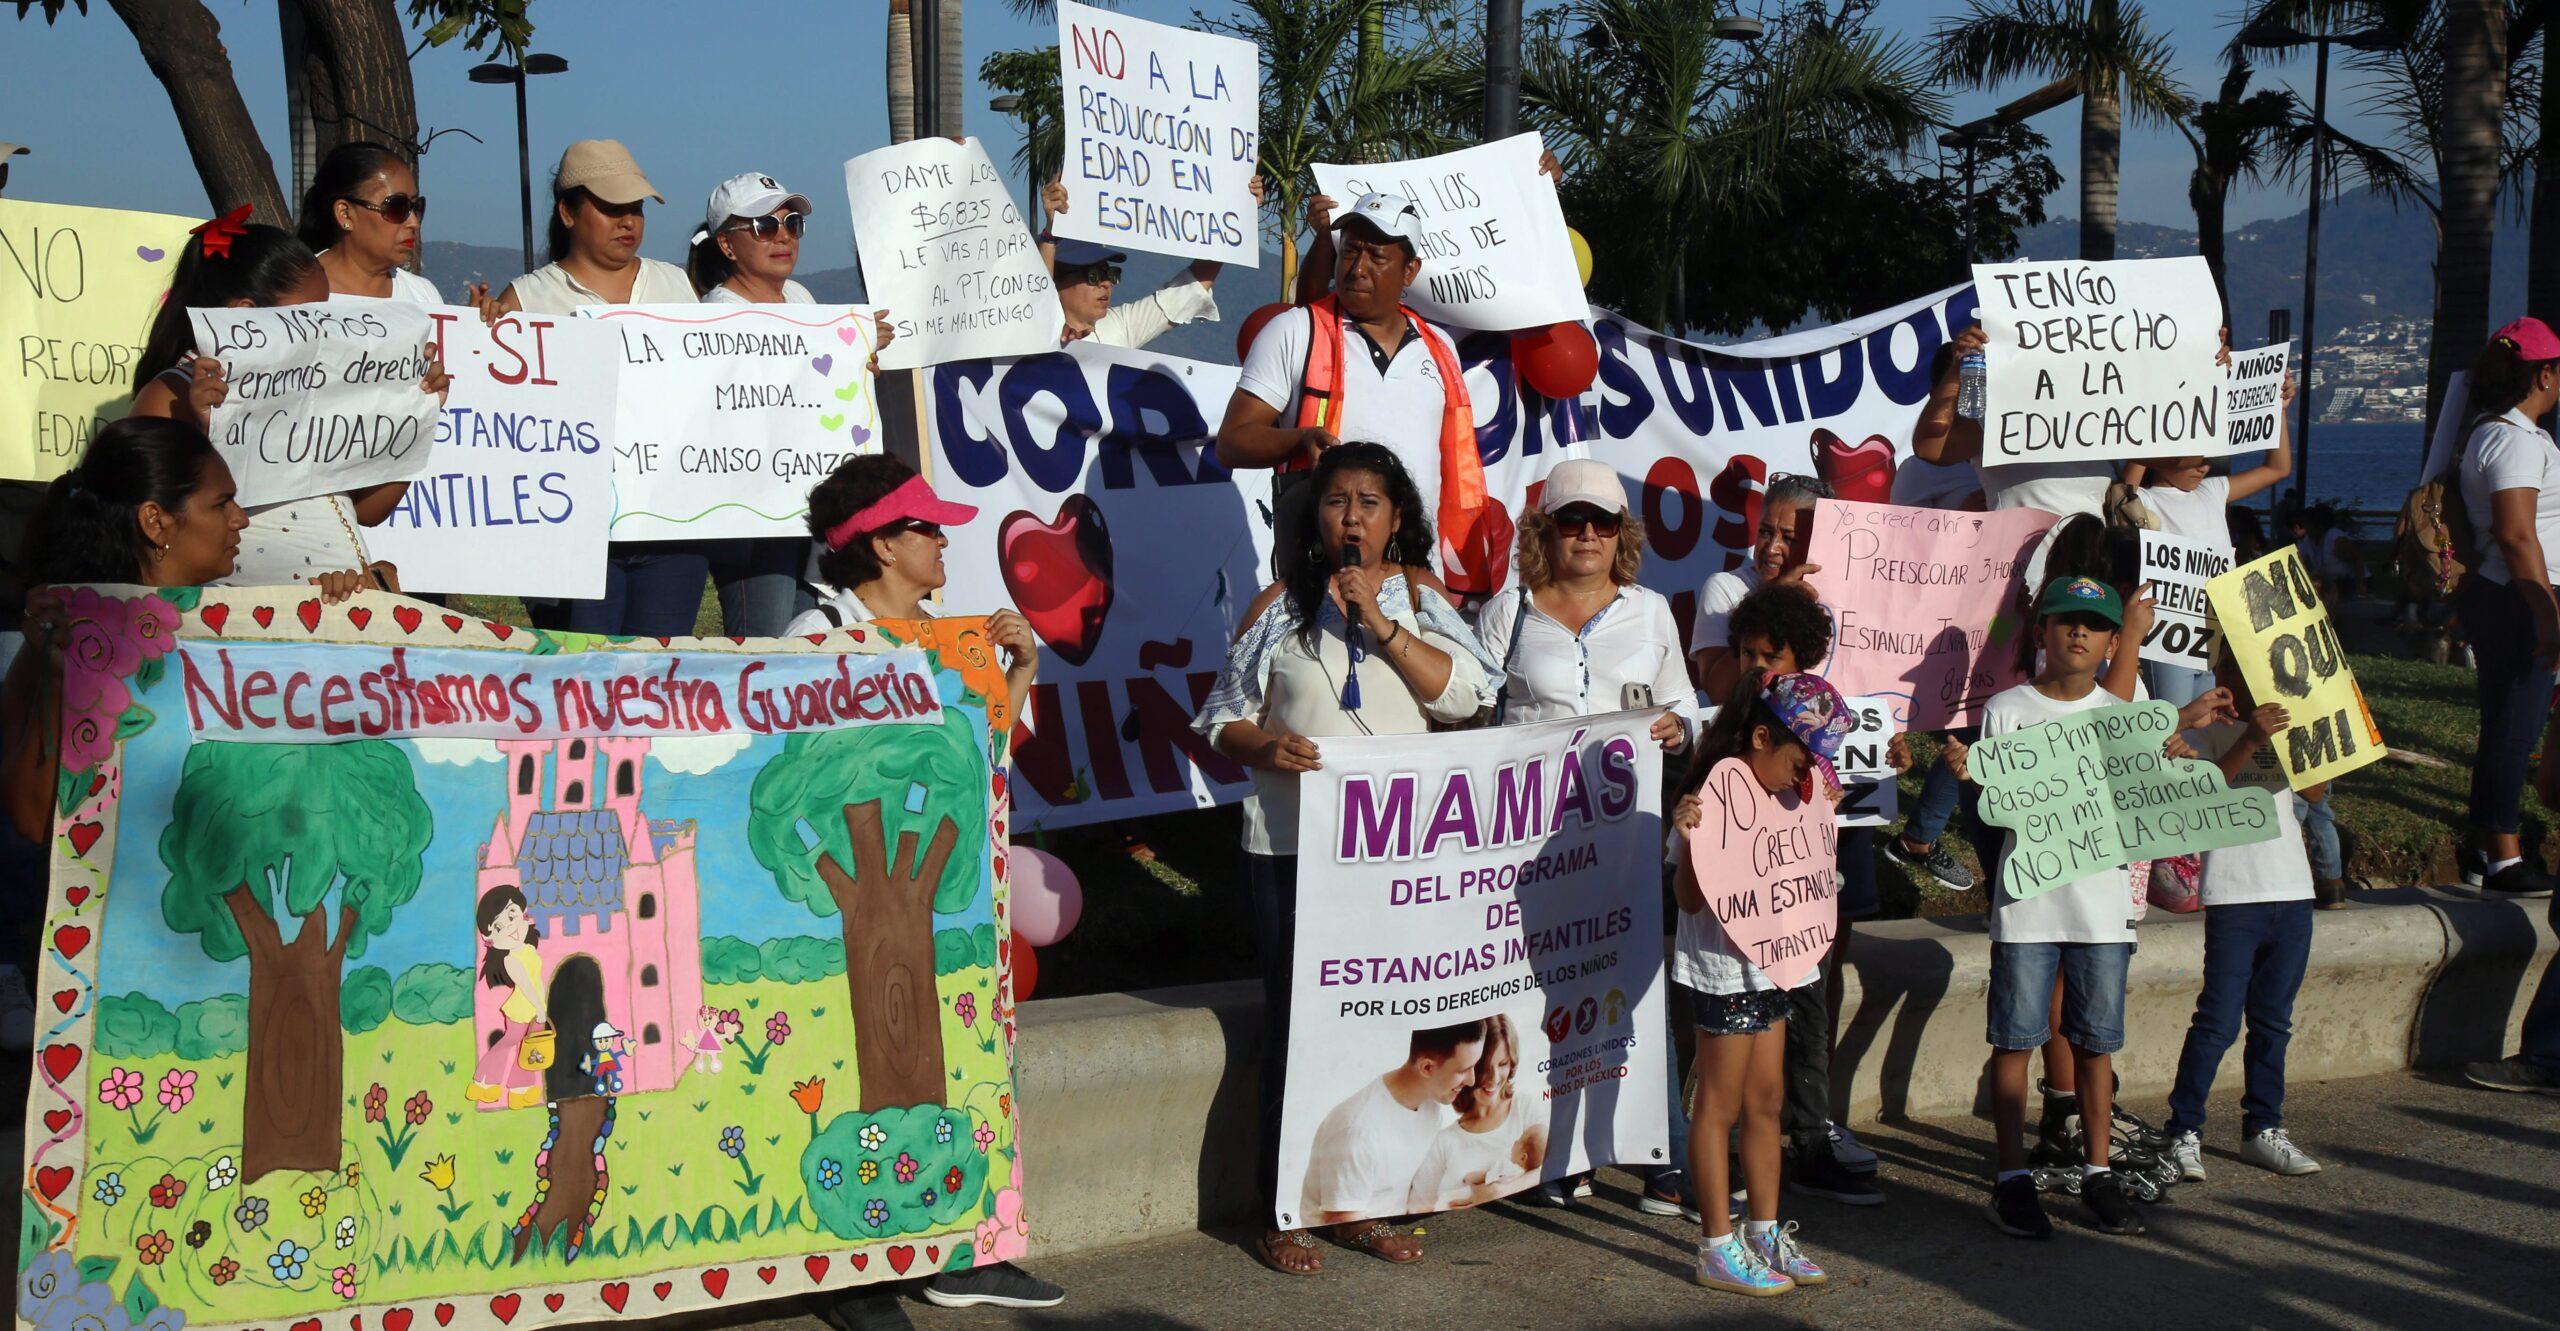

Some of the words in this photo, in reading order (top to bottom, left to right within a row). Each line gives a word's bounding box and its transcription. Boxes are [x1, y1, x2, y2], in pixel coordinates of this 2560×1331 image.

[1072, 23, 1125, 80] NO
[1150, 51, 1170, 93] A
[1189, 60, 1231, 102] LA
[1079, 84, 1212, 156] REDUCCIÓN
[1231, 127, 1255, 164] DE
[881, 164, 954, 194] DAME
[970, 163, 998, 186] LOS
[1081, 137, 1150, 187] EDAD
[1171, 159, 1213, 194] EN
[911, 199, 992, 232] $6,835
[1098, 191, 1242, 247] ESTANCIAS
[1400, 179, 1429, 220] A
[1429, 172, 1481, 212] LOS
[899, 246, 927, 270] LE
[940, 241, 971, 262] VAS
[978, 238, 989, 261] A
[996, 232, 1028, 258] DAR
[1470, 218, 1507, 250] DE
[932, 285, 951, 307] AL
[990, 272, 1023, 300] CON
[1027, 274, 1049, 293] ESO
[1429, 264, 1497, 304] NIÑOS
[1994, 266, 2116, 310] TENGO
[621, 323, 664, 364] LA
[683, 332, 809, 358] CIUDADANIA
[897, 321, 918, 338] SI
[925, 317, 944, 336] ME
[951, 303, 1034, 334] MANTENGO
[2014, 308, 2178, 353] DERECHO
[225, 362, 327, 400] tenemos
[343, 344, 430, 385] derecho
[2034, 369, 2055, 400] A
[2082, 362, 2124, 396] LA
[2236, 353, 2284, 380] NIÑOS
[2000, 380, 2219, 456] EDUCACIÓN
[2239, 383, 2277, 409] DERECHO
[226, 412, 252, 446] al
[259, 409, 419, 464] CUIDADO
[434, 408, 601, 454] STANCIAS
[2228, 413, 2274, 446] IDADO
[613, 442, 659, 475] ME
[680, 445, 762, 474] CANSO
[389, 472, 573, 528] ANTILES
[1833, 503, 1855, 535] Yo
[1866, 509, 1923, 529] crecí
[1927, 513, 1965, 535] ahí
[1840, 528, 1969, 585] PREESCOLAR
[2146, 542, 2181, 570] LOS
[2185, 547, 2229, 578] NIÑOS
[2240, 553, 2317, 633] NO
[1838, 610, 1923, 656] ESTANCIA
[2140, 620, 2215, 659] VOZ
[180, 647, 542, 736] Necesitamos
[553, 658, 731, 732] nuestra
[737, 654, 940, 735] Guarderia
[1976, 740, 2038, 778] Mis
[2044, 706, 2172, 758] Primeros
[2286, 708, 2356, 776] MI
[2076, 747, 2175, 787] fueron
[1338, 727, 1638, 861] MAMÁS
[1709, 767, 1756, 849] YO
[2025, 812, 2063, 843] en
[2072, 787, 2104, 822] mi
[2113, 767, 2218, 811] estancia
[1753, 815, 1812, 877] CRECÍ
[1823, 822, 1837, 857] EN
[2010, 850, 2063, 894] NO
[2068, 826, 2110, 869] ME
[2116, 815, 2151, 850] LA
[2158, 796, 2266, 843] QUITES
[1391, 875, 1451, 906] DEL
[1459, 843, 1599, 898] PROGRAMA
[1717, 889, 1760, 924] UNA
[1771, 867, 1836, 914] ESTANCIA
[1486, 900, 1521, 931] DE
[1320, 943, 1497, 986] ESTANCIAS
[1503, 906, 1632, 965] INFANTILES
[1752, 922, 1834, 970] INFANTIL
[1340, 1000, 1384, 1017] POR
[1391, 997, 1431, 1016] LOS
[1436, 978, 1521, 1013] DERECHOS
[1523, 972, 1543, 991] DE
[1546, 961, 1577, 985] LOS
[1580, 951, 1618, 979] NIÑOS
[1537, 1046, 1592, 1073] CORAZONES
[1595, 1036, 1636, 1053] UNIDOS
[1565, 1065, 1582, 1080] POR
[1585, 1058, 1601, 1073] LOS
[1574, 1079, 1585, 1091] DE
